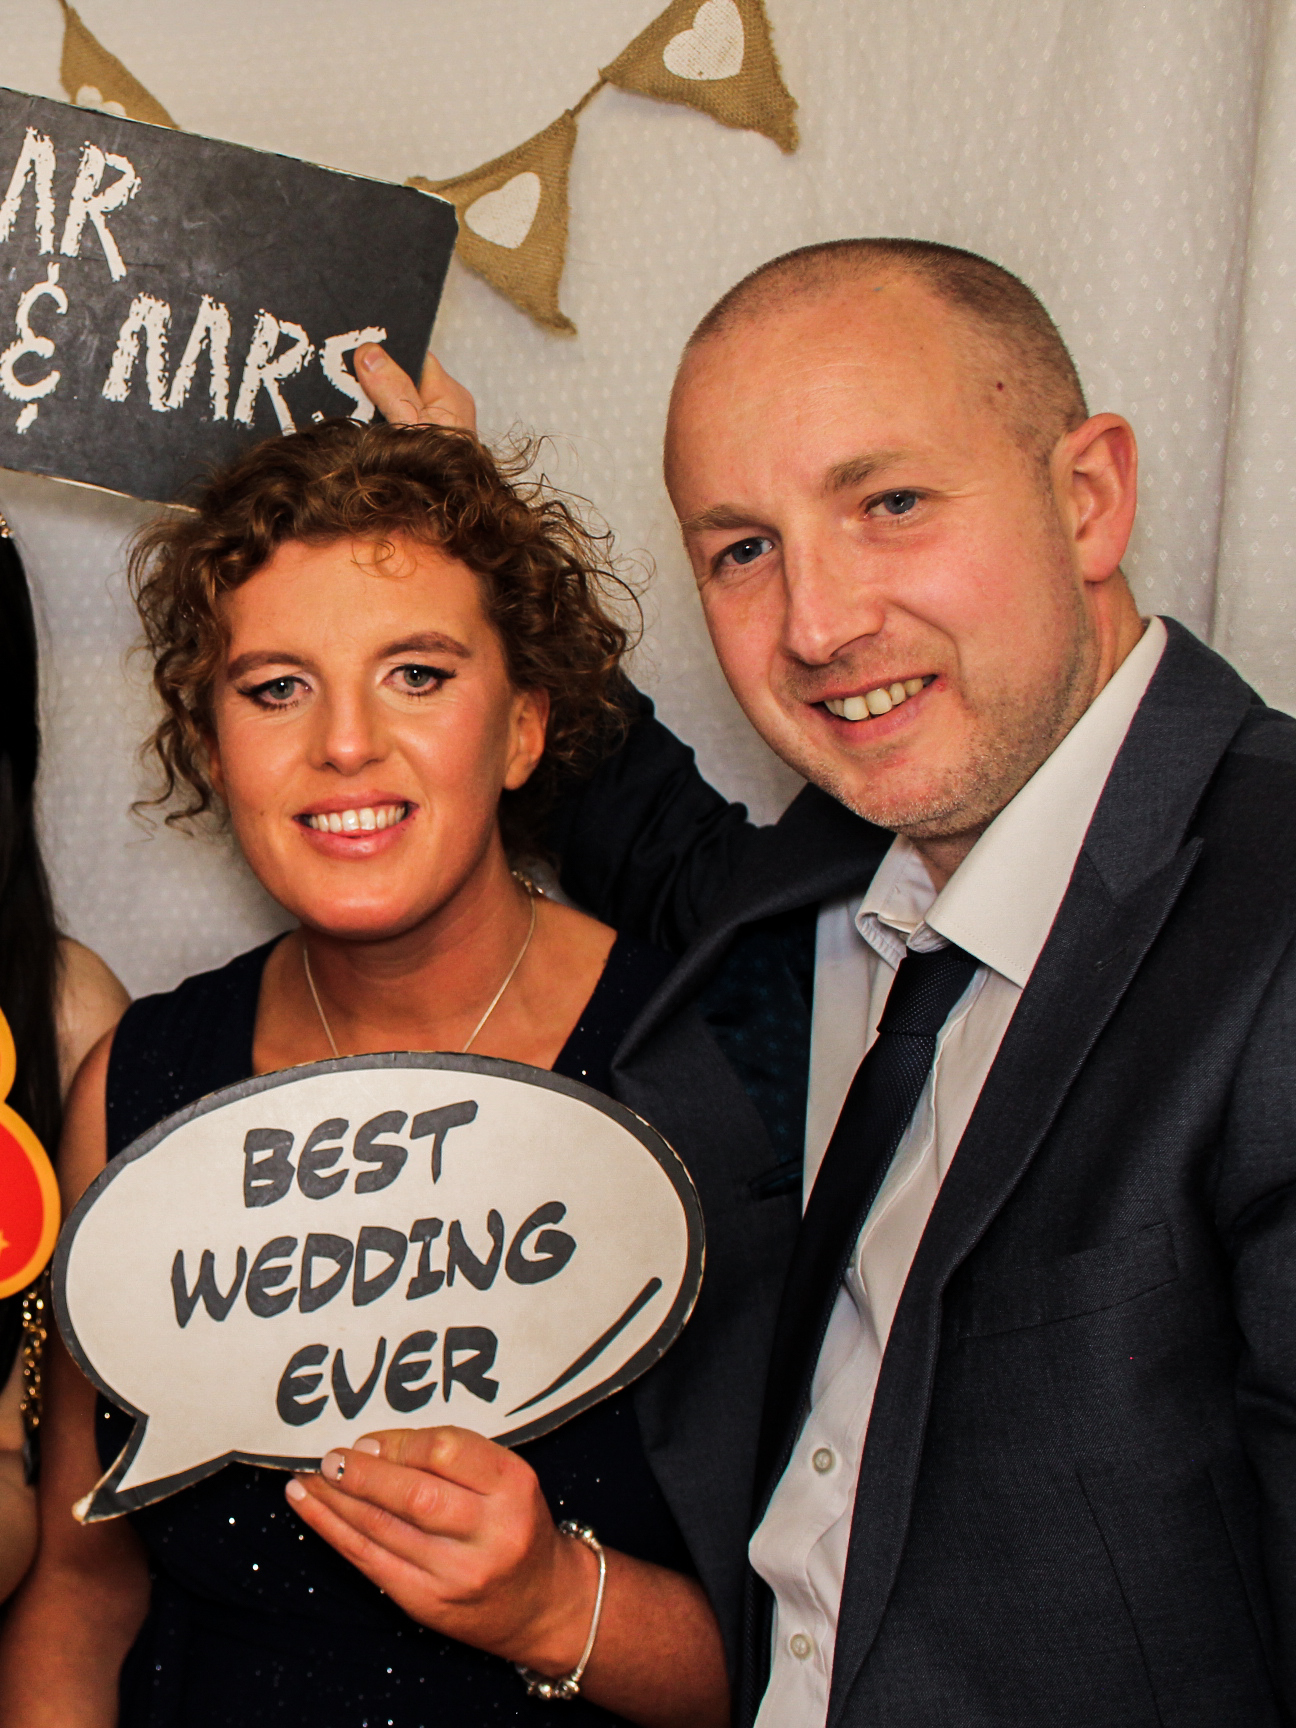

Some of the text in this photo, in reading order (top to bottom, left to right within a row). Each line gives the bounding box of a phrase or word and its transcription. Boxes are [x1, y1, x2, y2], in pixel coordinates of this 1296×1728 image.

[102, 292, 387, 436] MRS
[244, 1099, 479, 1208] BEST
[170, 1201, 577, 1329] WEDDING
[276, 1326, 500, 1427] EVER
